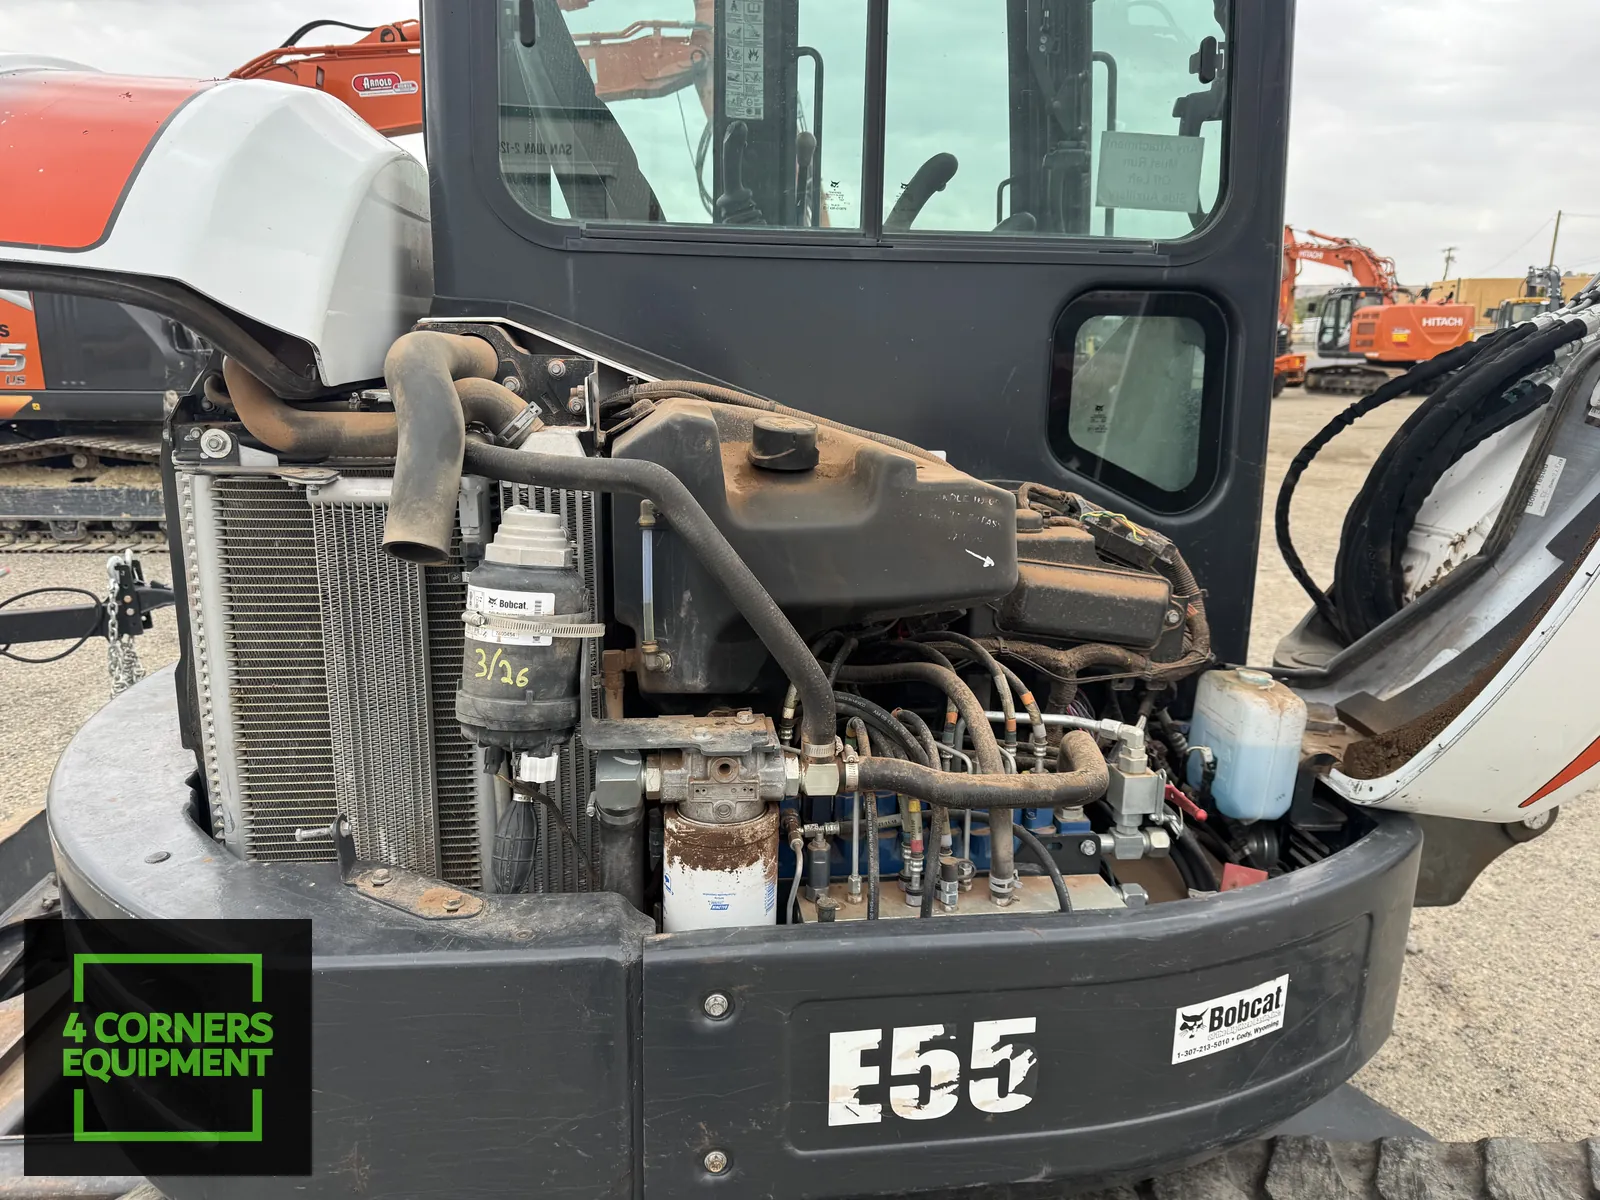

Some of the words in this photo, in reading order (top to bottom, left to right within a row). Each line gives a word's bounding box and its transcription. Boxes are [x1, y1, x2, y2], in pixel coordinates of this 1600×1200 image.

[363, 77, 392, 89] ARNOLD
[1422, 317, 1464, 327] HITACHI
[5, 375, 26, 386] US
[499, 599, 527, 610] Bobcat
[475, 648, 529, 688] 3/26
[1209, 986, 1282, 1033] Bobcat
[1177, 1039, 1230, 1059] 1-307-213-5010
[1236, 1030, 1252, 1042] Cody,
[1254, 1020, 1280, 1035] Wyoming
[828, 1017, 1038, 1127] E55
